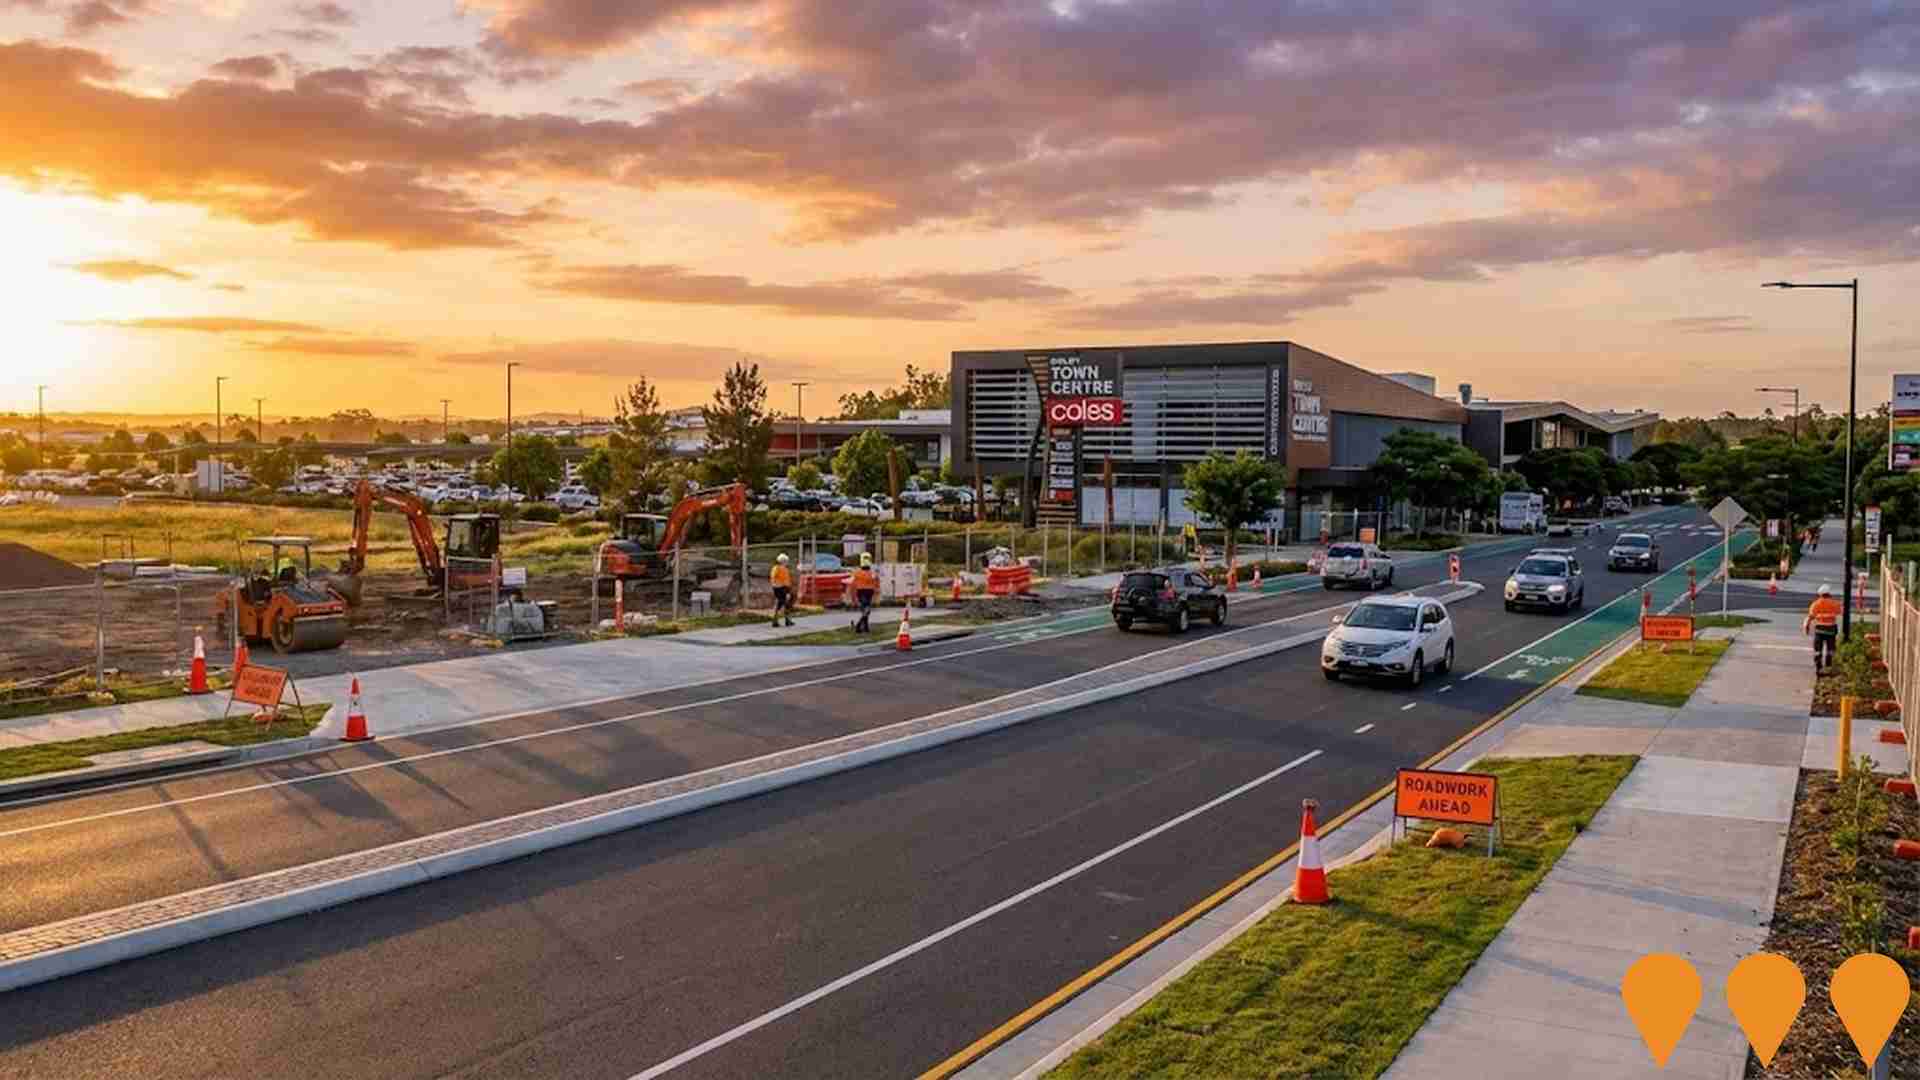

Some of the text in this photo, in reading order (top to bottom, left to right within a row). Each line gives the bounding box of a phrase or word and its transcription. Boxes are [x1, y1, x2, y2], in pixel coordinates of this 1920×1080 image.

[1051, 366, 1099, 379] TOWN
[1050, 381, 1113, 394] CENTRE
[1051, 399, 1114, 421] coles
[1405, 778, 1488, 798] ROADWORK
[1419, 798, 1471, 814] AHEAD
